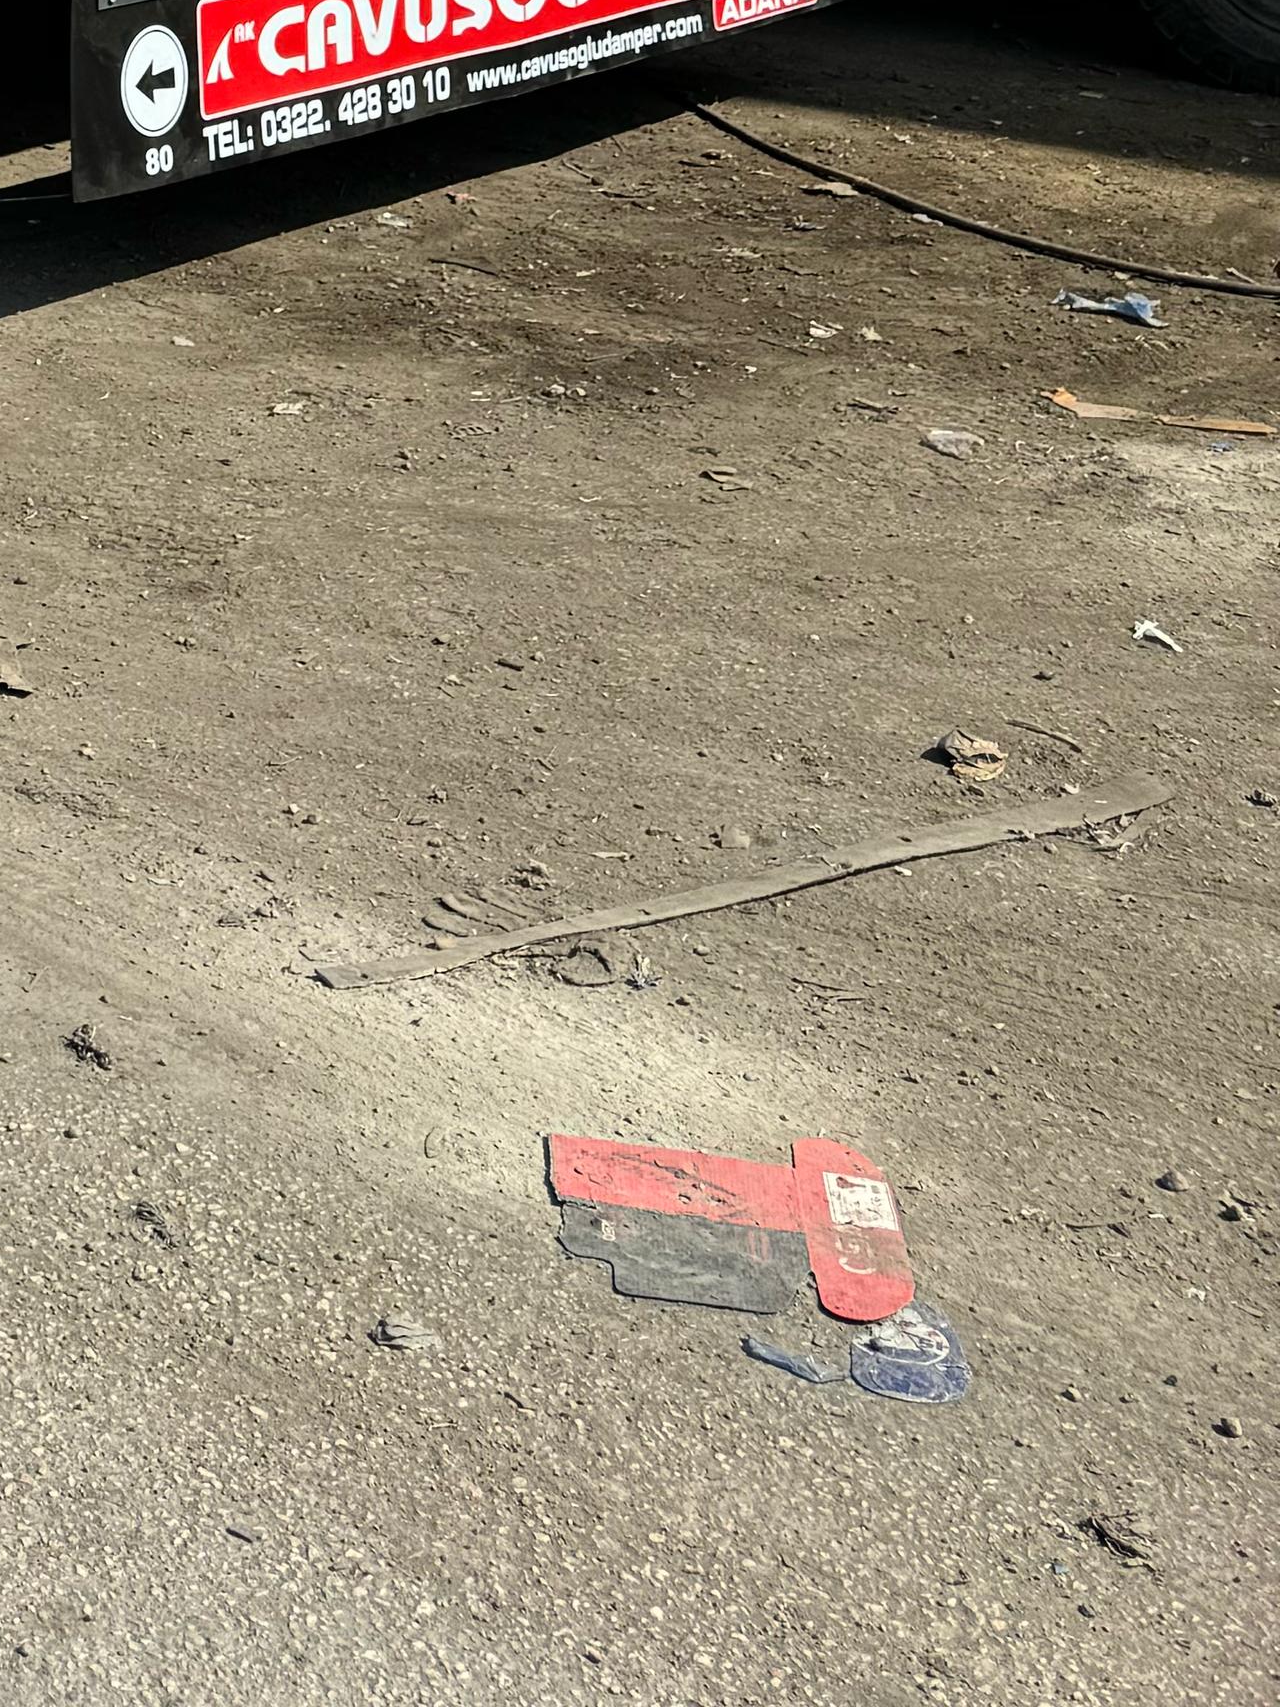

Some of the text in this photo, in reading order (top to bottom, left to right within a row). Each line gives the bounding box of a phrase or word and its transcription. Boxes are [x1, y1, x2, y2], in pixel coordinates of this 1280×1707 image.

[233, 20, 256, 44] AK
[202, 13, 703, 162] TEL: 0322. 428 30 10 www.cavusogludamper.com
[144, 144, 174, 177] 80
